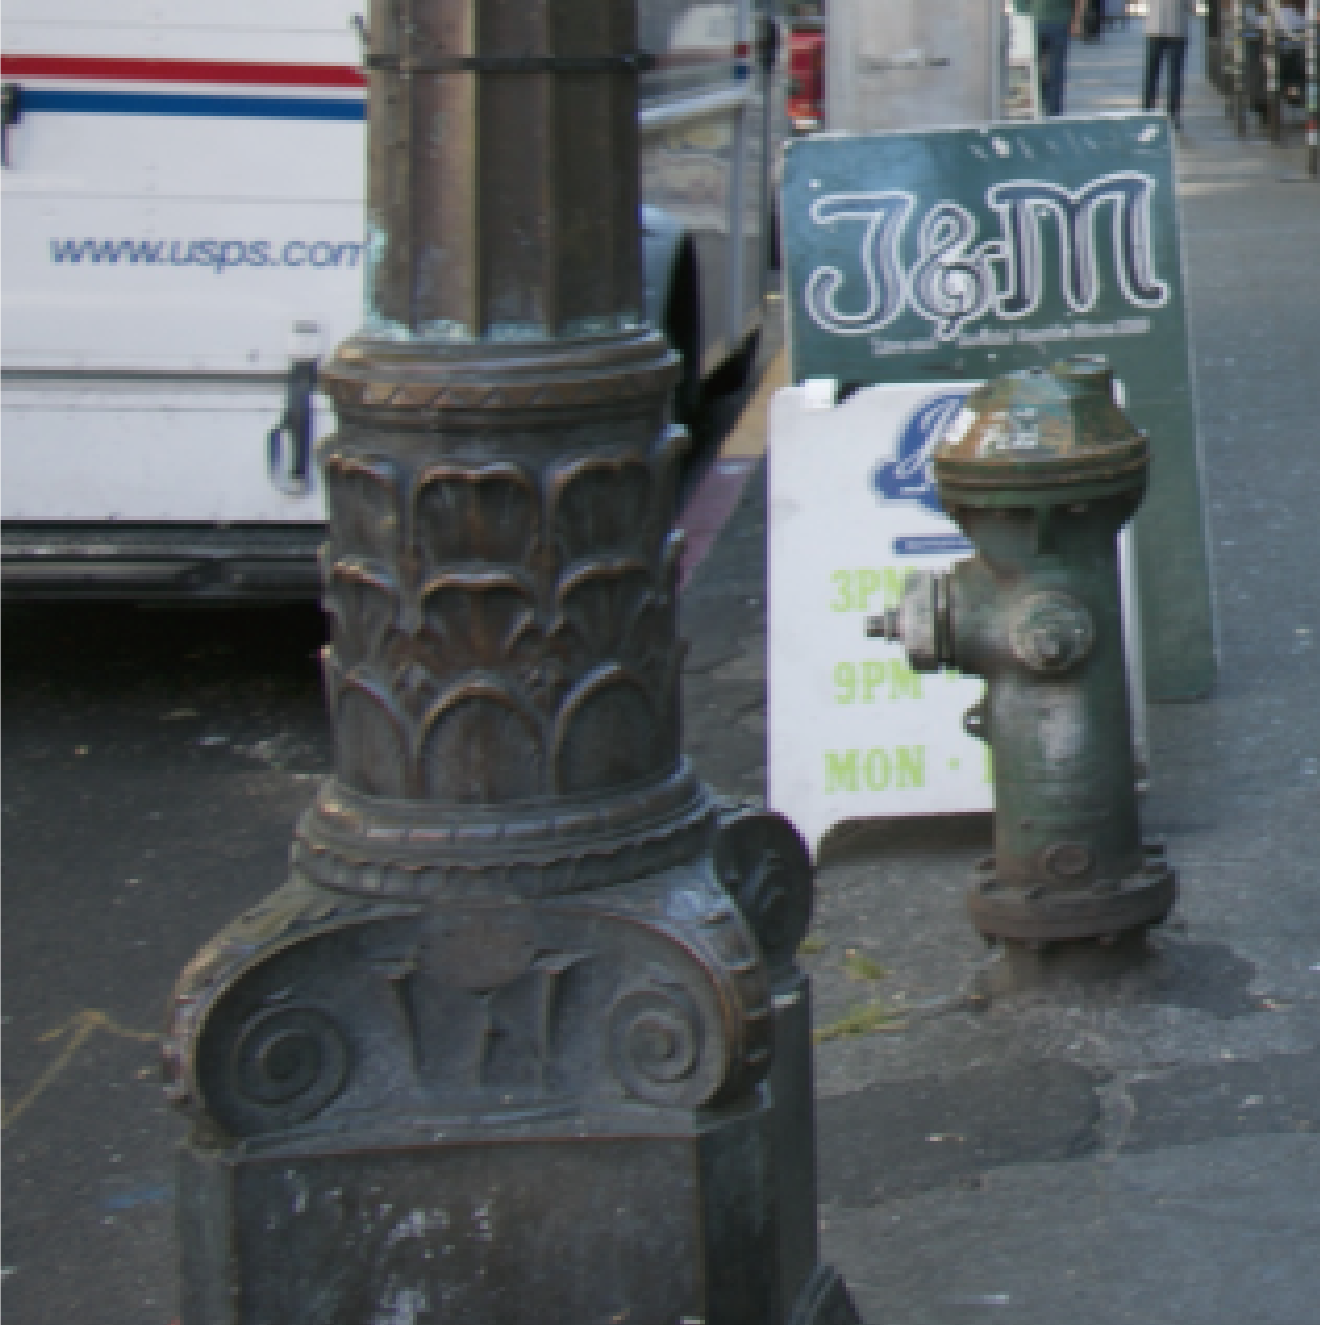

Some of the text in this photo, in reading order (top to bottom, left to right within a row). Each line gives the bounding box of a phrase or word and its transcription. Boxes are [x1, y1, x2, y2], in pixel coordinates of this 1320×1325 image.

[48, 236, 368, 277] www.usps.com
[804, 169, 1172, 342] J&M
[833, 660, 924, 706] 9PM
[823, 745, 927, 794] MON
